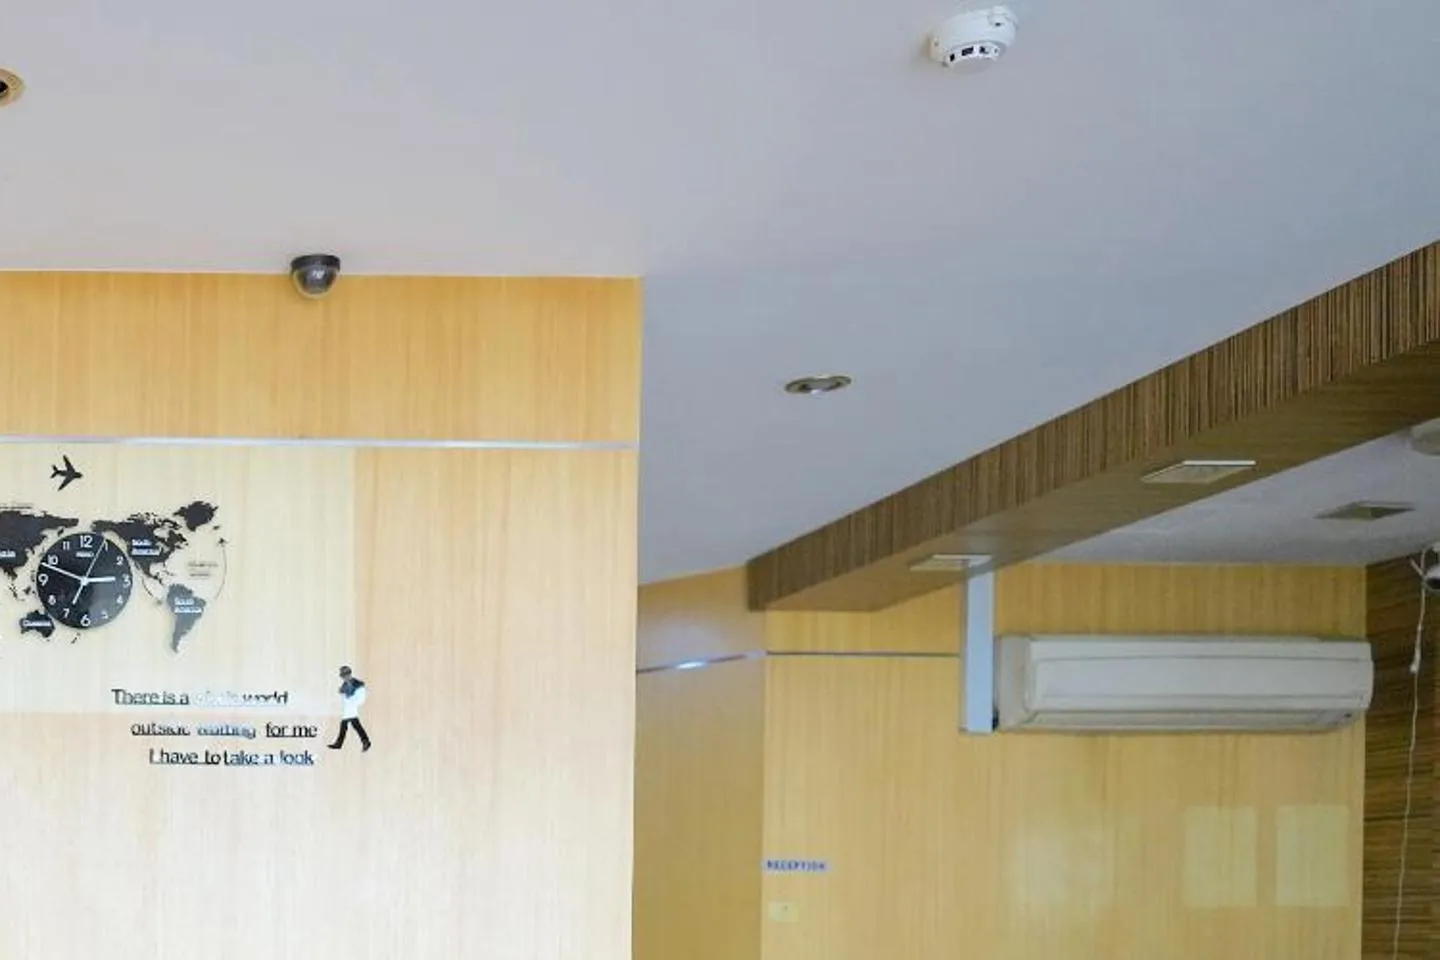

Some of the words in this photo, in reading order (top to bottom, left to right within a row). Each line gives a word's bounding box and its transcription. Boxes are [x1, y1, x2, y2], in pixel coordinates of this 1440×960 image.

[62, 541, 70, 551] 11
[80, 535, 93, 548] 12
[47, 554, 59, 565] 10
[116, 556, 124, 566] 2
[38, 573, 49, 587] 9
[122, 573, 131, 588] 3
[47, 595, 56, 606] 8
[116, 595, 124, 605] 4
[62, 608, 70, 619] 7
[80, 614, 91, 627] 6
[111, 688, 160, 706] There
[162, 690, 176, 706] is
[179, 693, 189, 706] a
[265, 722, 290, 738] for
[293, 724, 318, 738] me
[160, 747, 199, 765] have
[205, 749, 221, 765] to
[223, 749, 260, 765] take
[264, 753, 274, 765] a
[280, 749, 315, 766] look
